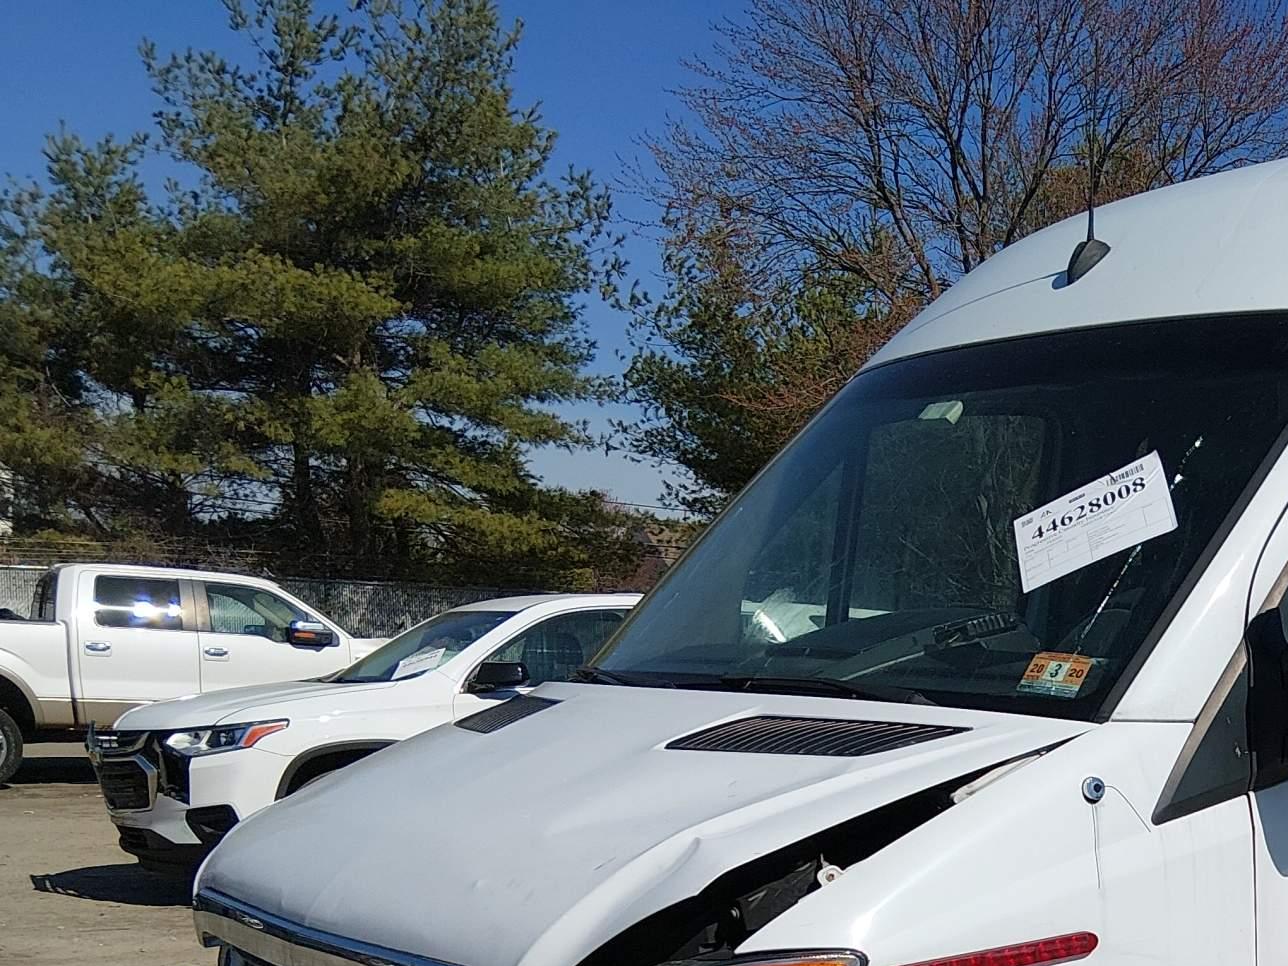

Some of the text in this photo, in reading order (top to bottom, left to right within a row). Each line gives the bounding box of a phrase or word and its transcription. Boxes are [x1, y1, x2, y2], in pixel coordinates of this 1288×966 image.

[1032, 476, 1146, 540] 44628008
[1030, 664, 1045, 673] 20
[1050, 664, 1062, 678] 3
[1068, 668, 1084, 678] 20
